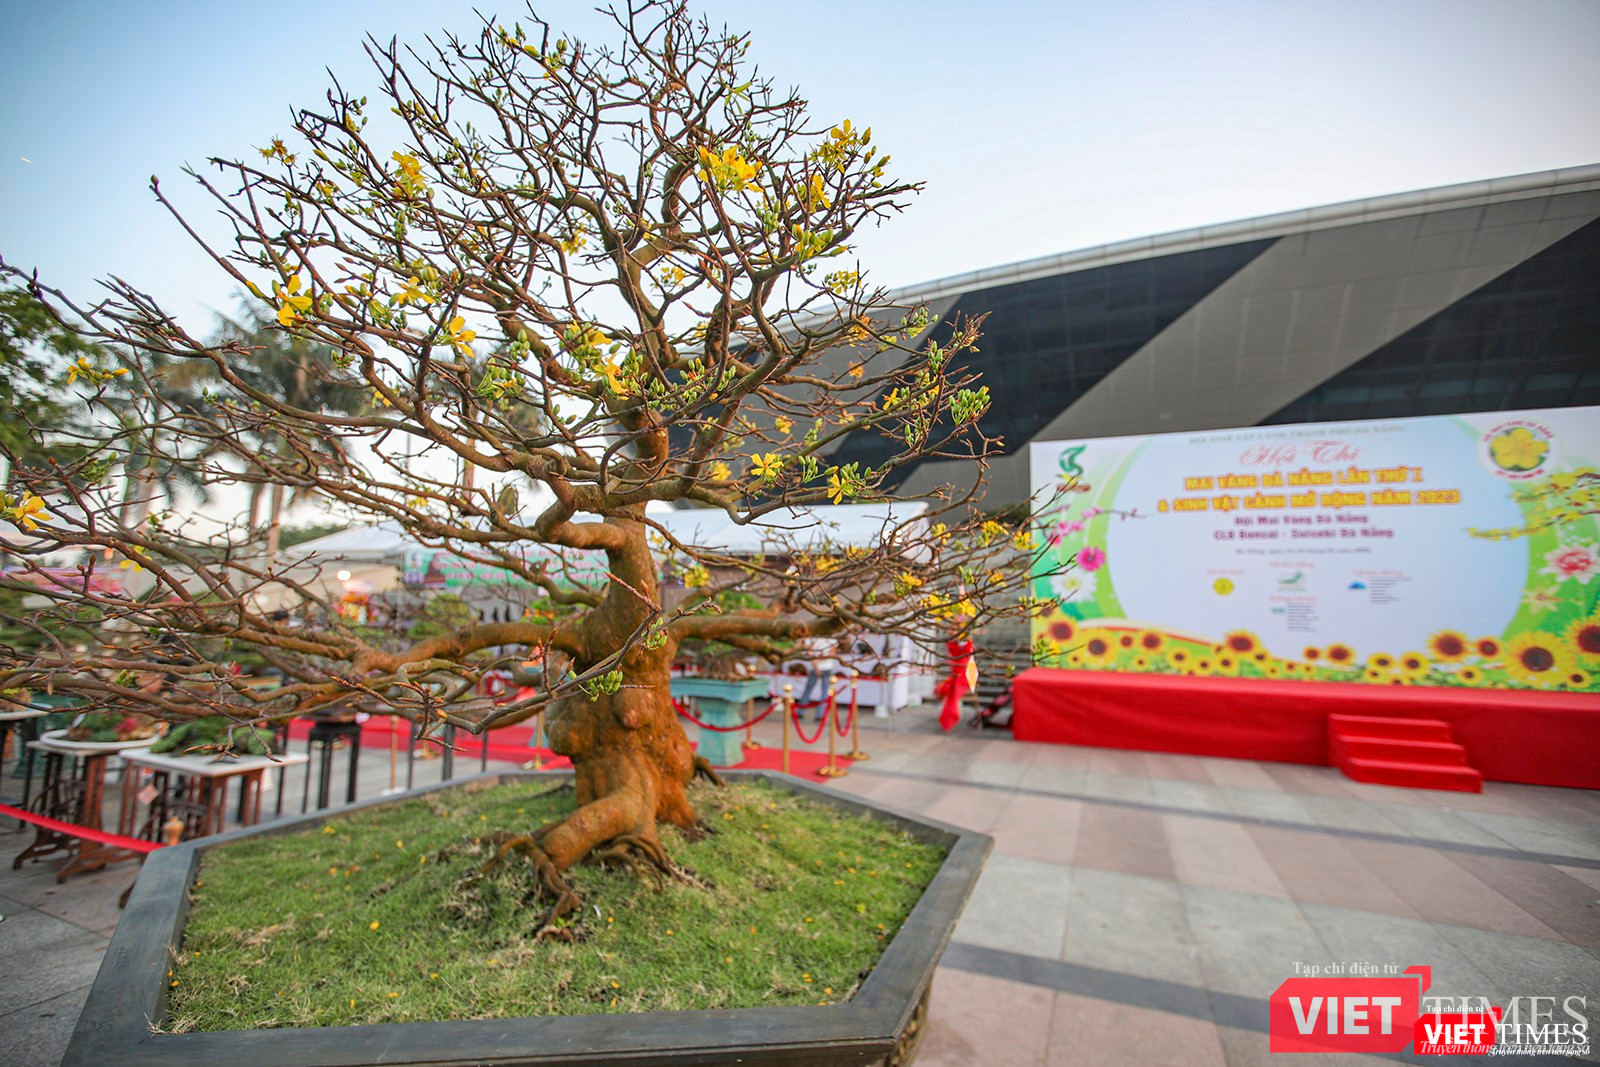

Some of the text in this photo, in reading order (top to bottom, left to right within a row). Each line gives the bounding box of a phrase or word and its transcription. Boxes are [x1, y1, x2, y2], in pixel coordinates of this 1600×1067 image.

[1303, 439, 1362, 464] Thi
[1184, 476, 1214, 491] MAI
[1217, 472, 1258, 489] VÀNG
[1157, 499, 1169, 512] &
[1173, 497, 1208, 512] SINH
[1212, 494, 1239, 513] VẬT
[1243, 491, 1286, 509] CẢNH
[1290, 490, 1317, 508] MỞ
[1320, 491, 1367, 509] RỘNG
[1416, 489, 1461, 505] 2023
[1257, 516, 1279, 525] Mai
[1214, 531, 1235, 540] CLB
[1239, 530, 1279, 539] Bonsai
